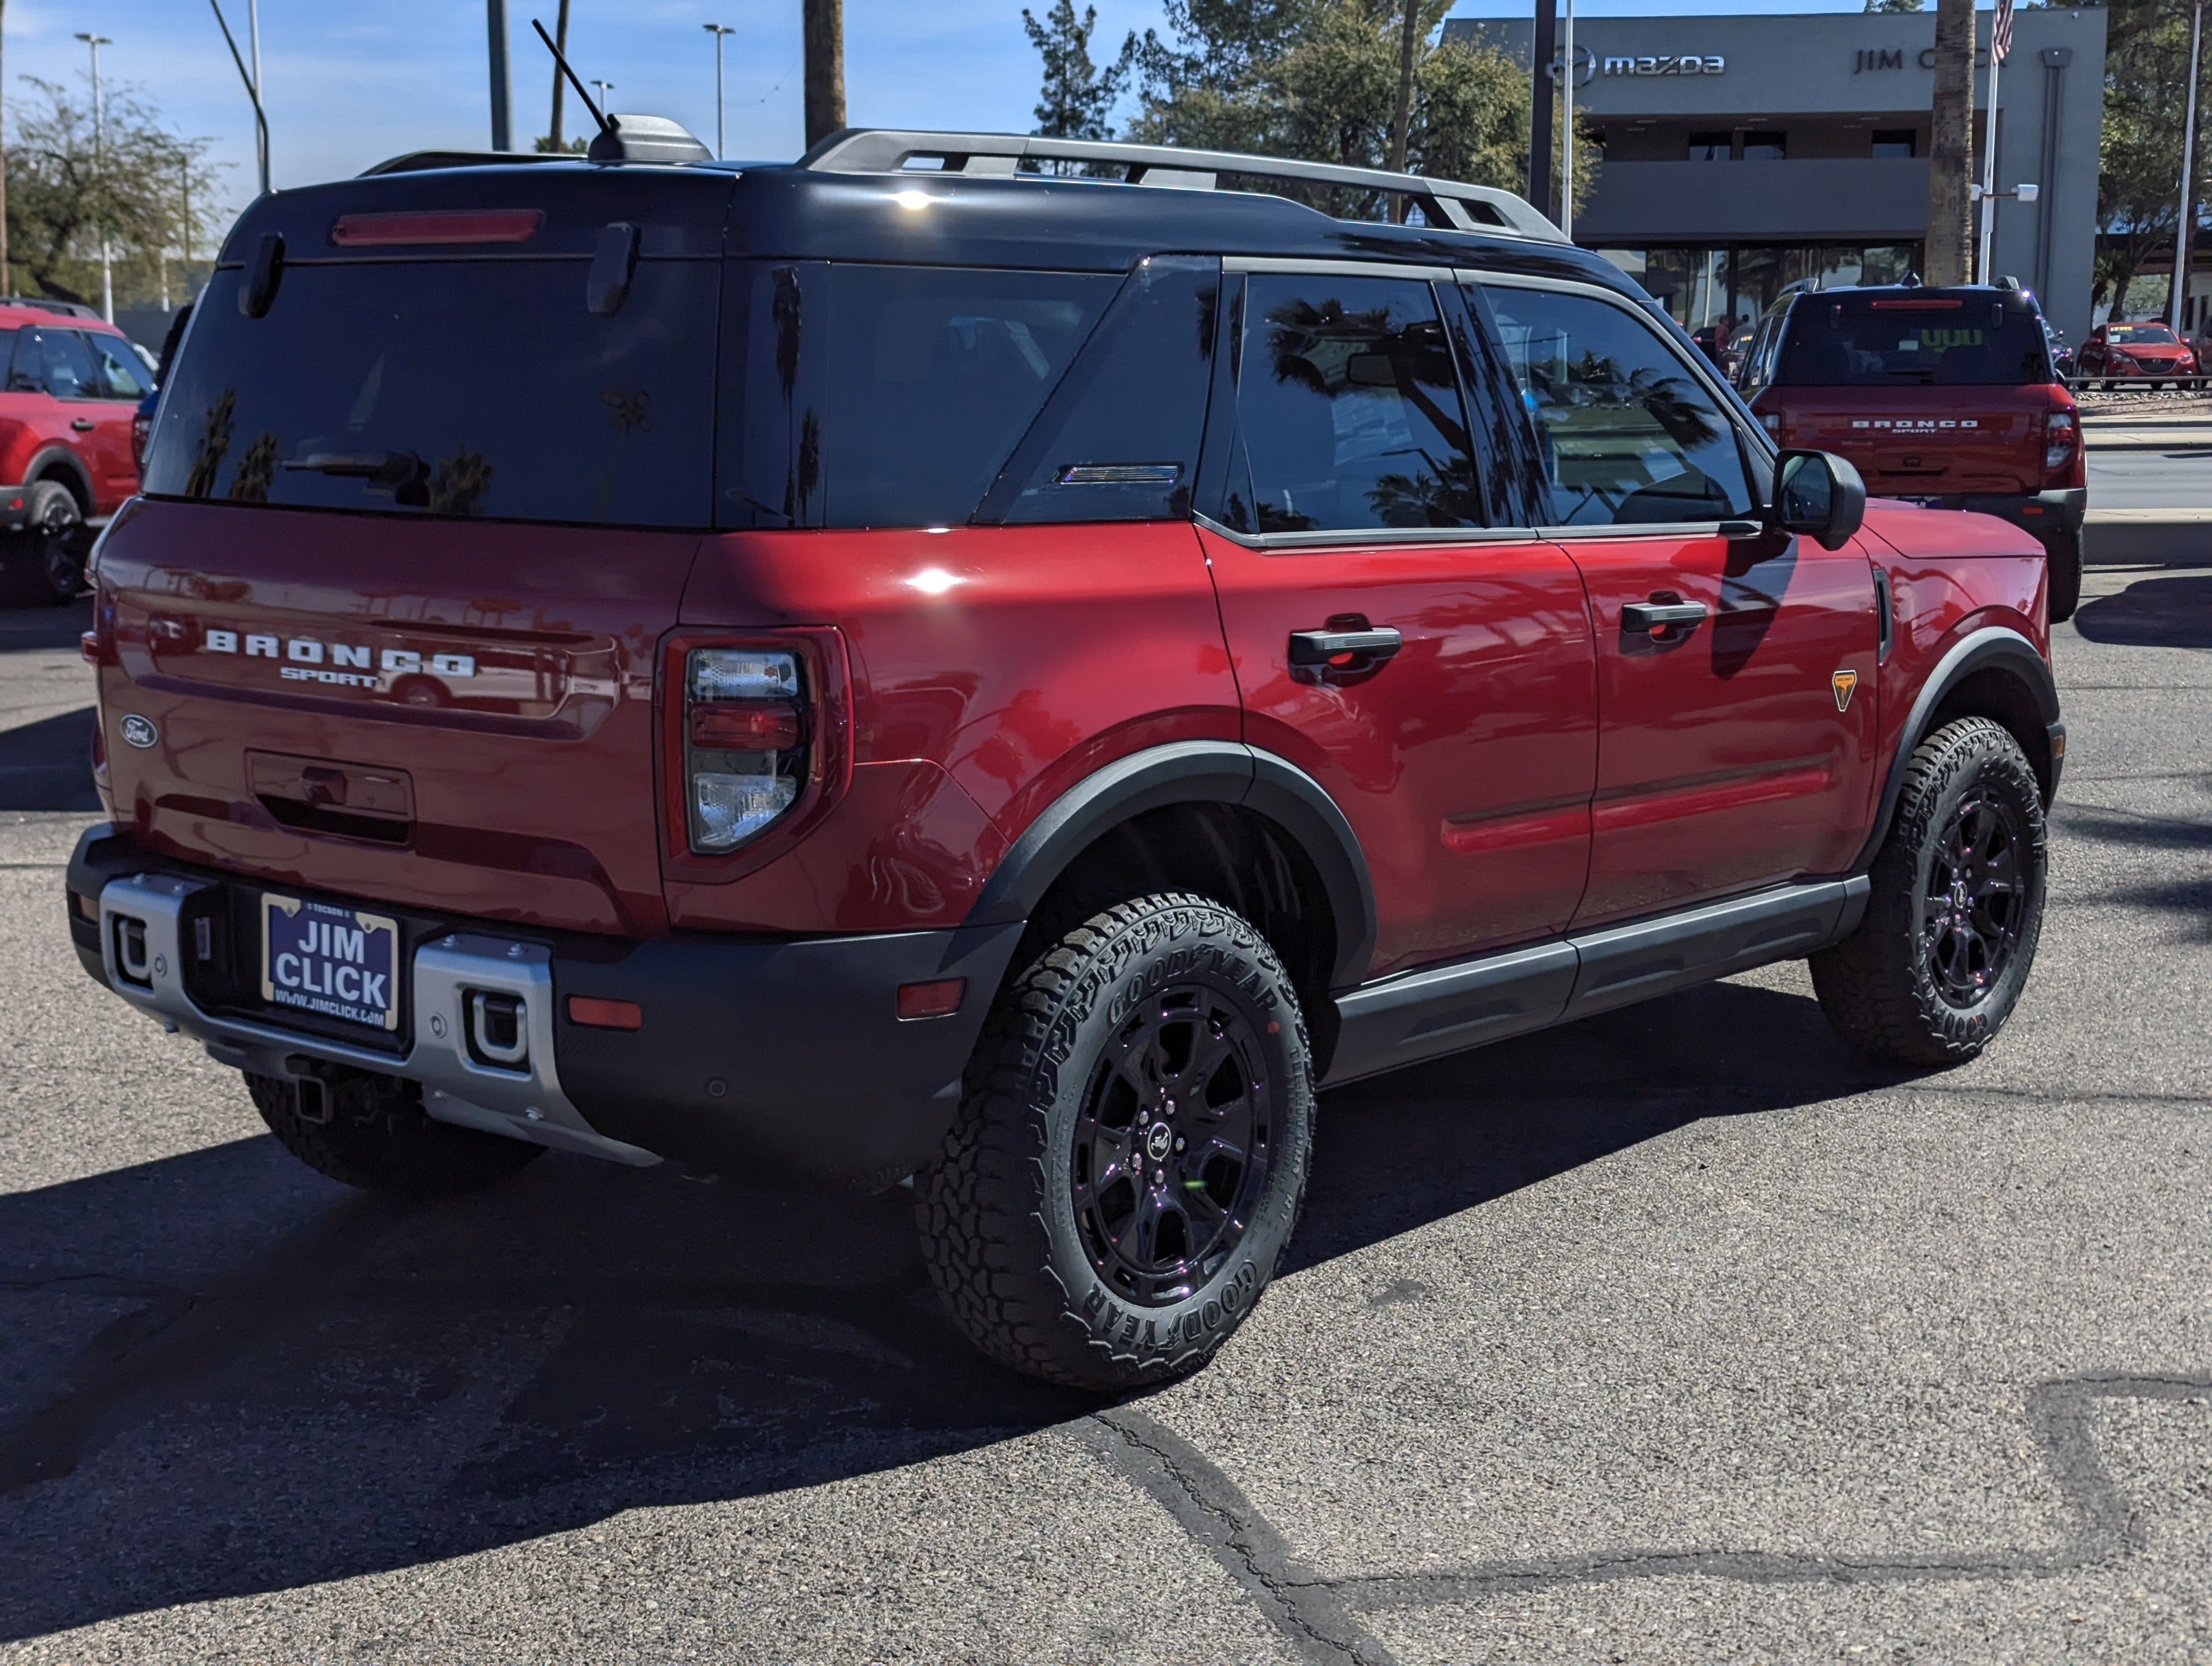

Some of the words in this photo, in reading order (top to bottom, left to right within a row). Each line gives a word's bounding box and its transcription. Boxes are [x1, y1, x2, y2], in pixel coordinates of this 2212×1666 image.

[1853, 48, 1903, 74] JIM
[1852, 420, 1978, 428] BRONCO
[206, 629, 476, 678] BRONCO
[280, 667, 378, 688] SPORT
[313, 903, 343, 917] TUCSON
[298, 920, 365, 964] JIM
[276, 952, 387, 1009] CLICK
[275, 989, 384, 1027] WWW.JIMCLICK.COM
